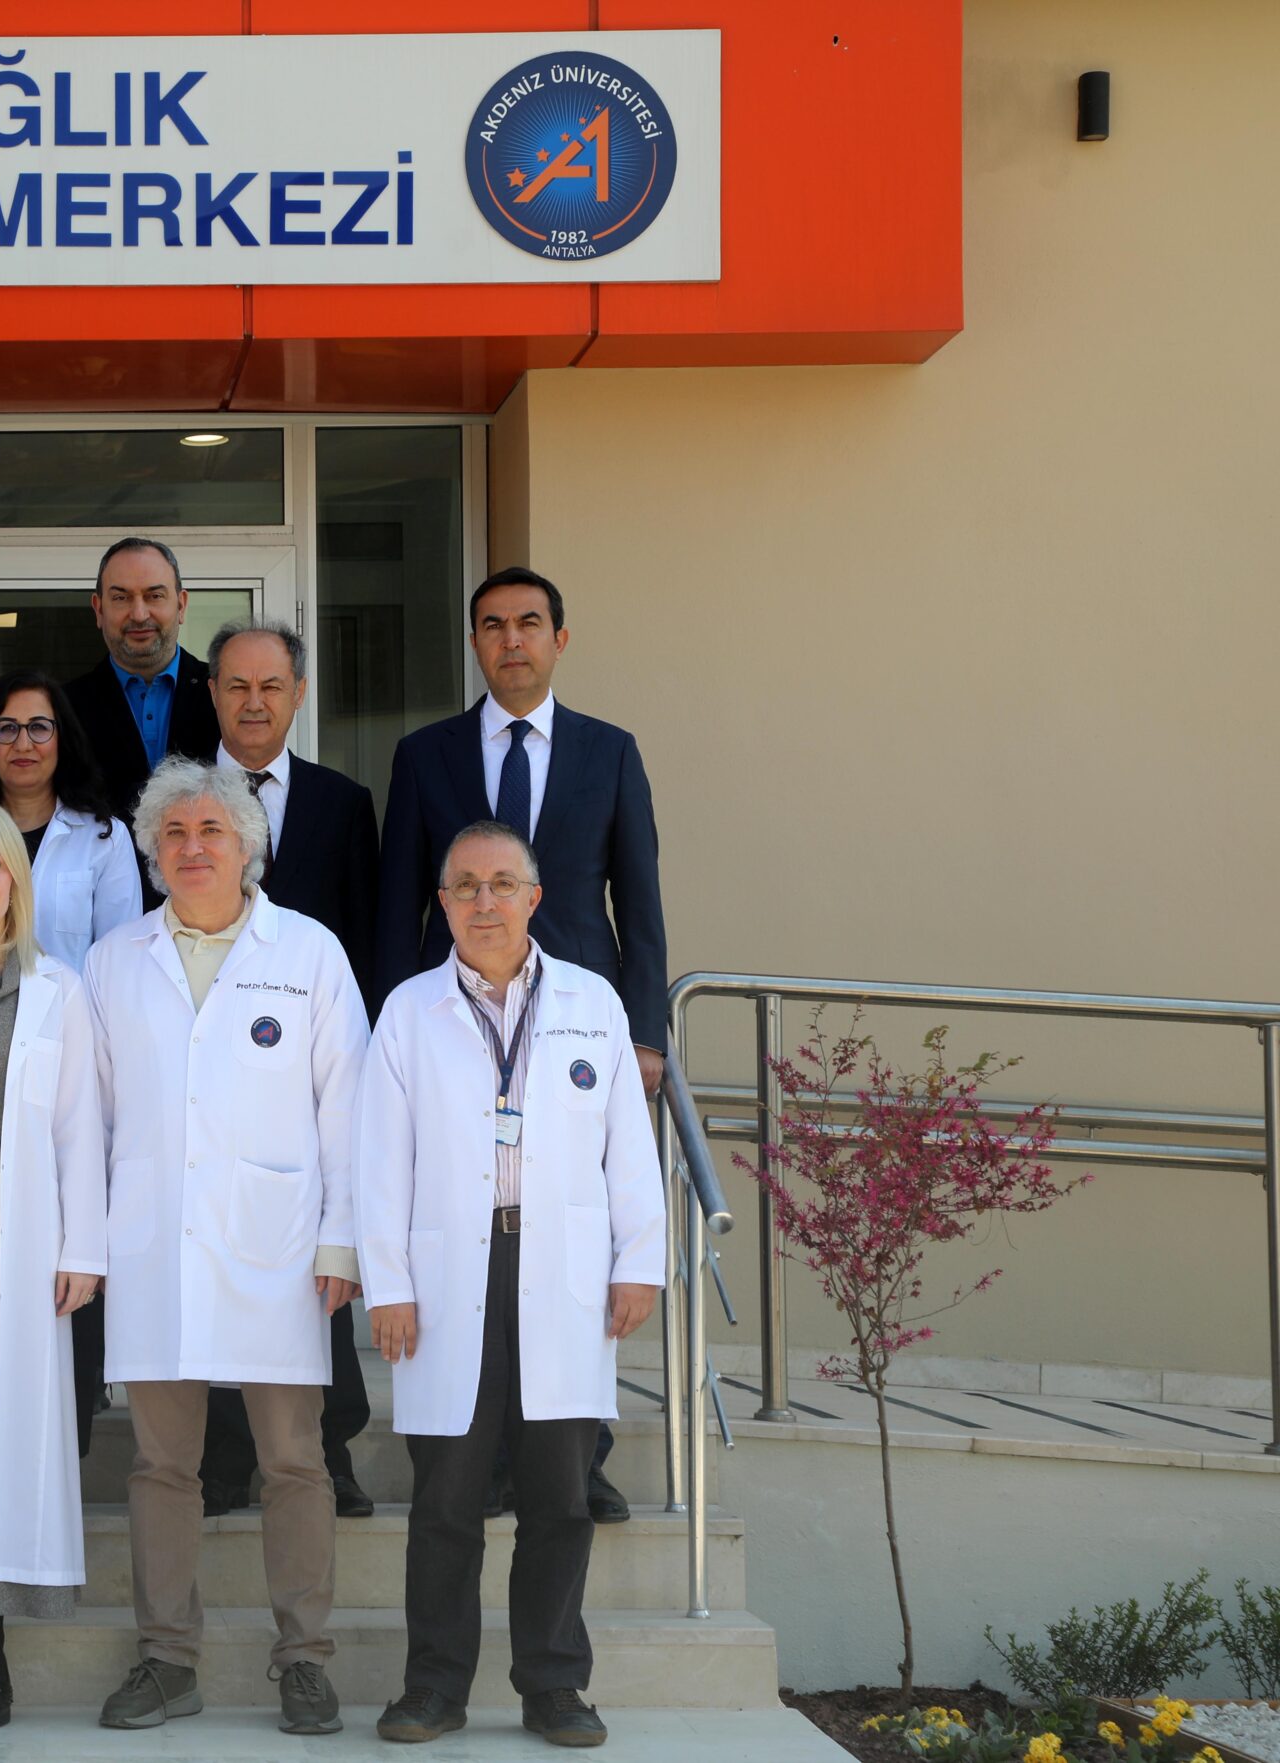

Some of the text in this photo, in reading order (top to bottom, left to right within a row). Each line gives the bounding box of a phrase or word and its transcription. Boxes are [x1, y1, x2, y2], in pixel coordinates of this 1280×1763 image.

[479, 64, 663, 144] AKDENİZ ÜNİVERSİTESİ
[550, 229, 589, 245] 1982
[542, 244, 597, 258] ANTALYA
[283, 984, 308, 996] ÖZKAN
